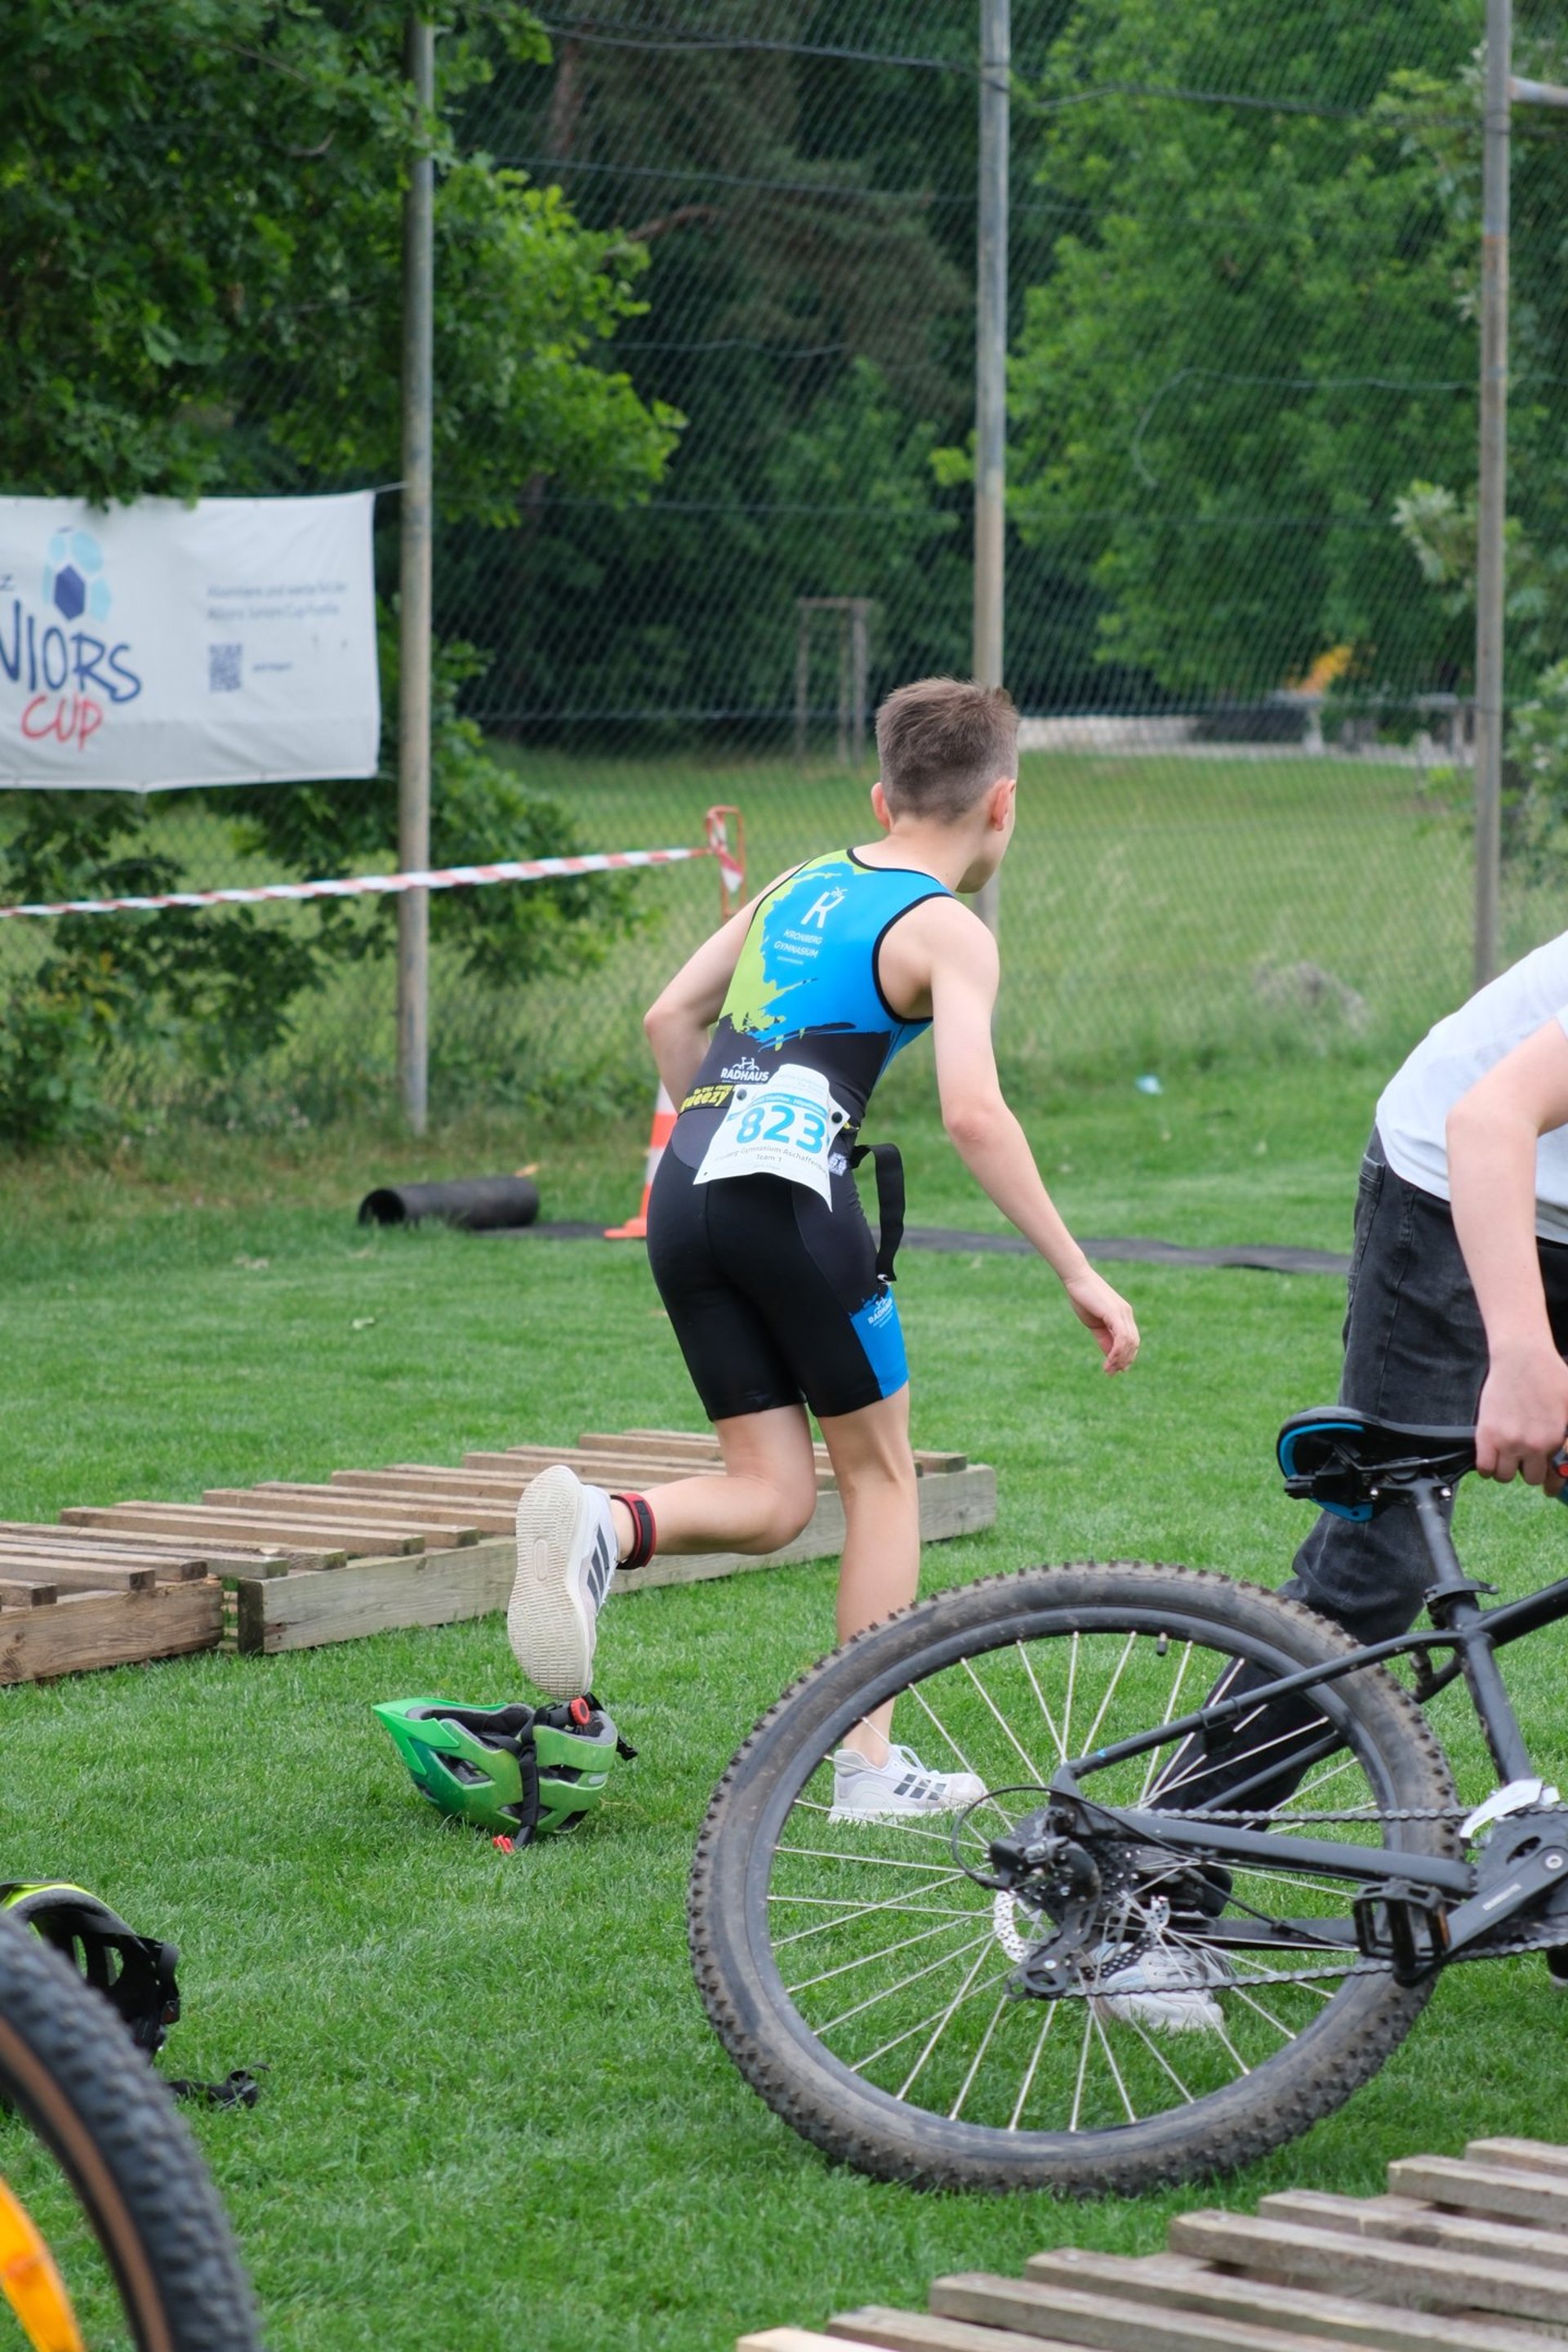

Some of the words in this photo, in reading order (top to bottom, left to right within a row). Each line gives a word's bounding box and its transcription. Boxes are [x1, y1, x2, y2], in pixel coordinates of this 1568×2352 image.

[21, 693, 104, 751] CUP
[784, 929, 823, 946] KRONBERG
[773, 940, 819, 959] GYMNASIUM
[720, 1067, 769, 1082] RADHAUS
[736, 1105, 826, 1154] 823
[756, 1153, 775, 1161] Team
